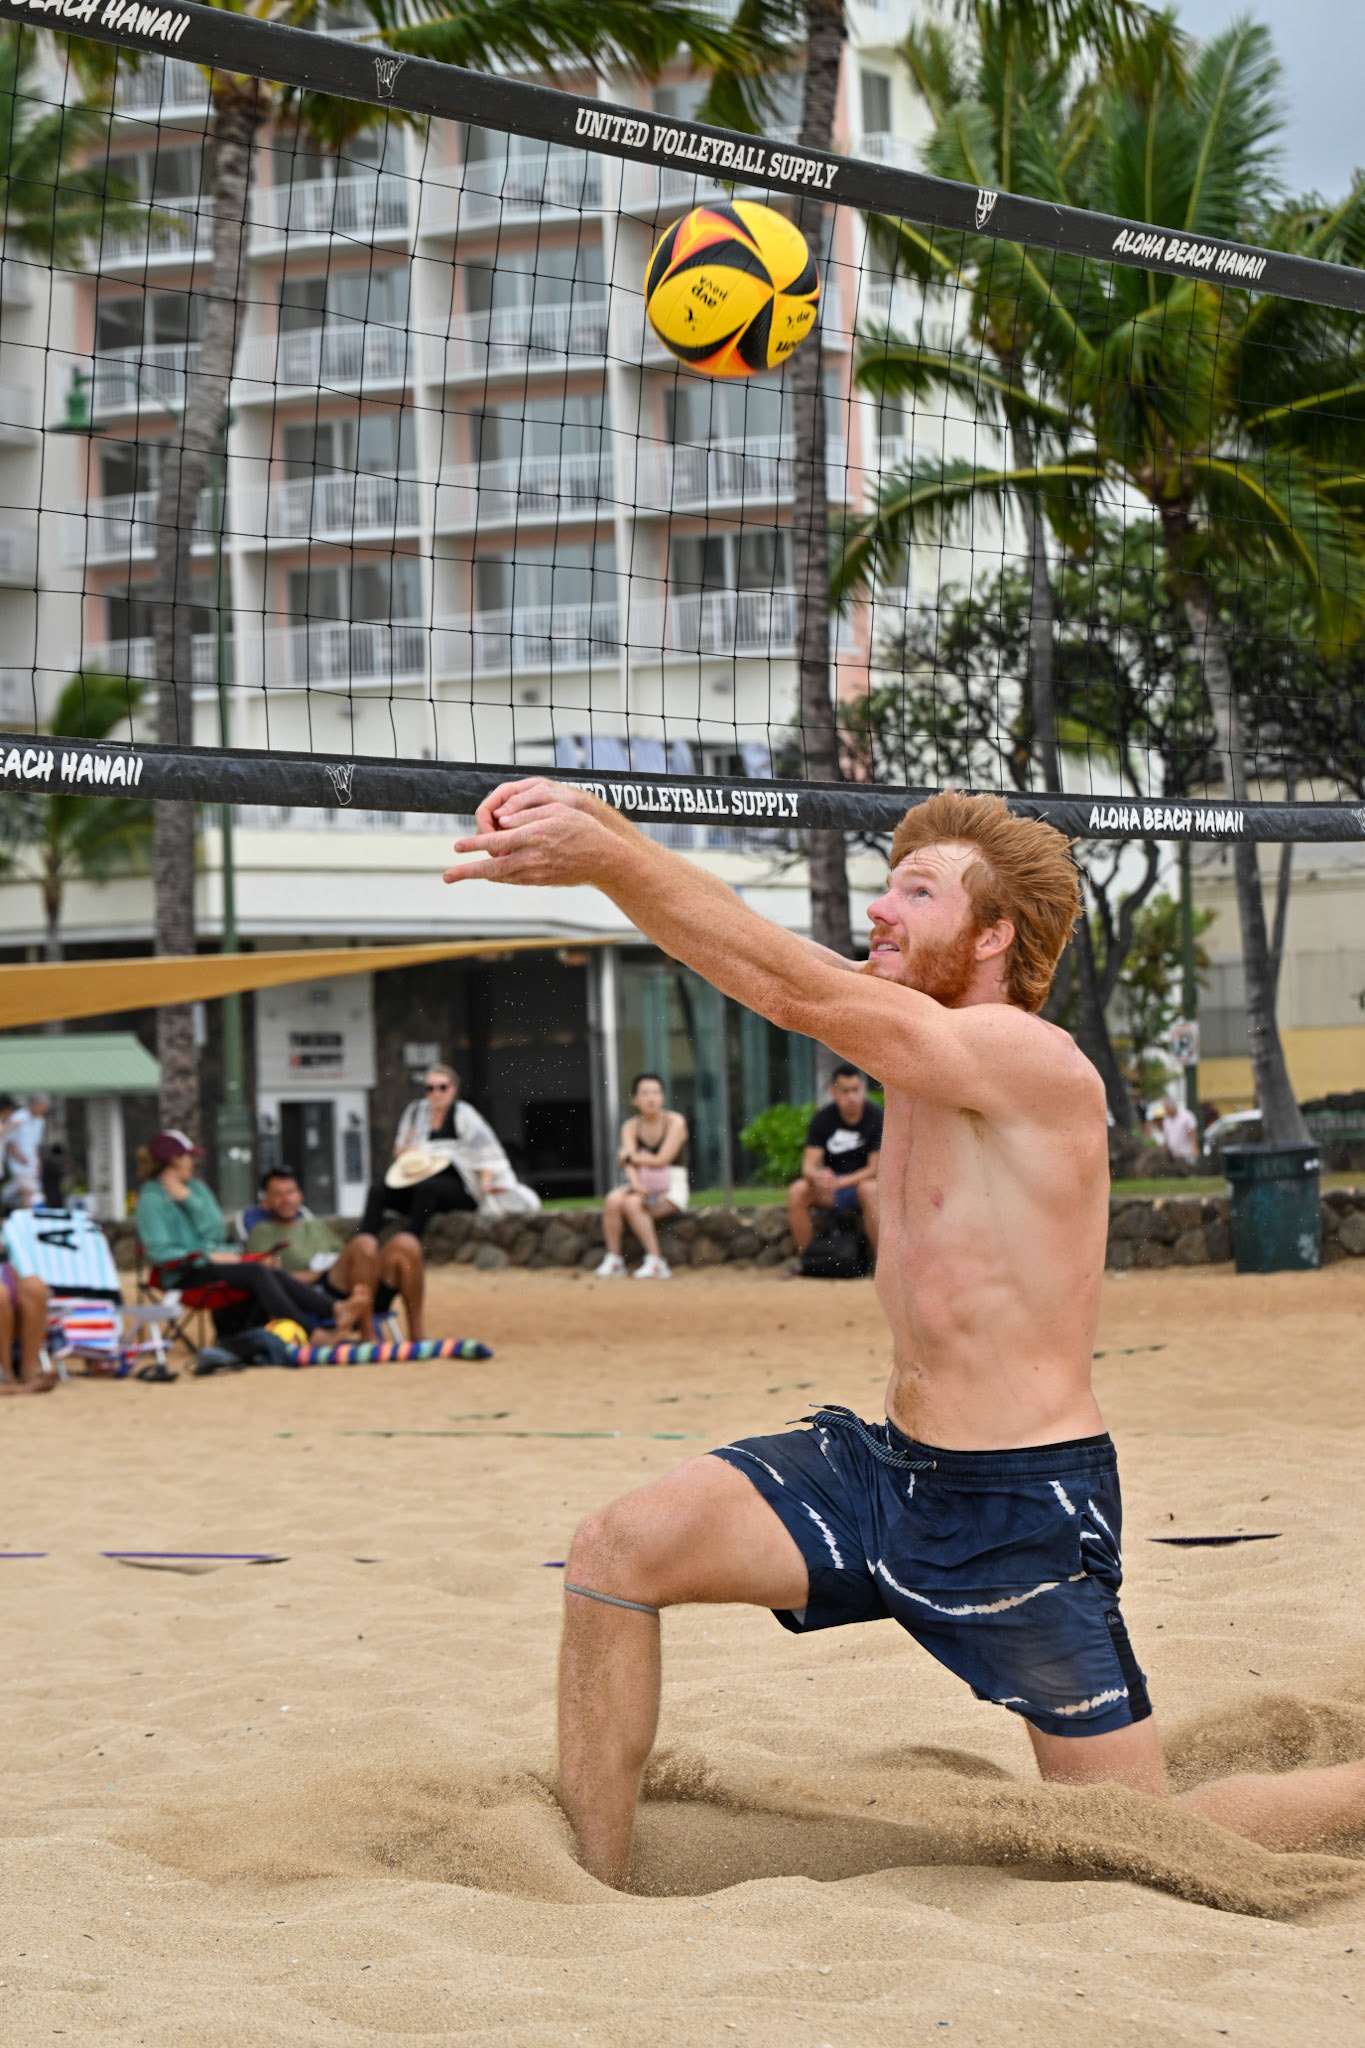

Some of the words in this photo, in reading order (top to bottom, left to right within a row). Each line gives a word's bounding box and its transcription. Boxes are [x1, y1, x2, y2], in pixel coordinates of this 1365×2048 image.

[100, 0, 191, 43] HAWAII
[574, 107, 650, 148] UNITED
[652, 125, 766, 176] VOLLEYBALL
[767, 152, 839, 190] SUPPLY
[1112, 228, 1166, 260] ALOHA
[1164, 238, 1217, 271] BEACH
[1215, 249, 1267, 280] HAWAII
[61, 752, 143, 786] HAWAII
[608, 784, 729, 815] VOLLEYBALL
[731, 789, 799, 818] SUPPLY
[1089, 805, 1142, 831] ALOHA
[1143, 806, 1192, 832] BEACH
[1195, 808, 1244, 833] HAWAII
